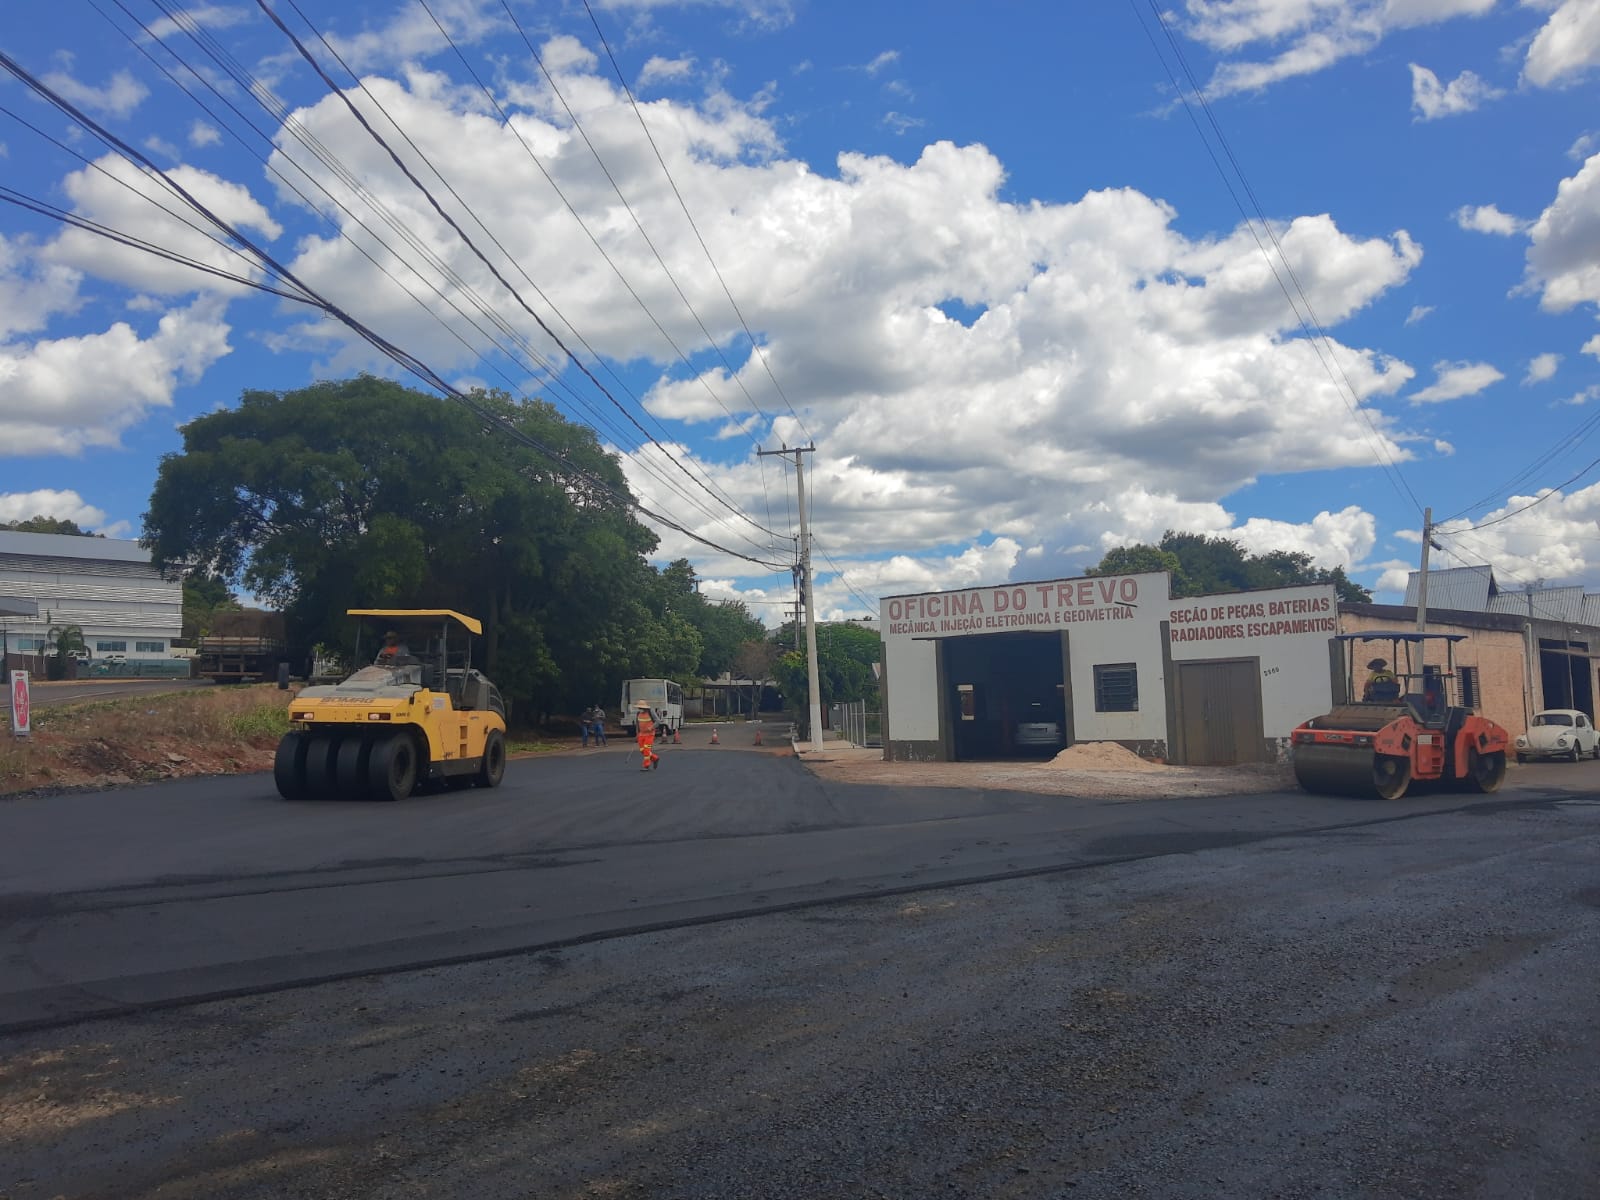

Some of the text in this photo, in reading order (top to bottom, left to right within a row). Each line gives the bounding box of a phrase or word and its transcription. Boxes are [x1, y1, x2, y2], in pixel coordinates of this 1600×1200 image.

[888, 578, 1138, 620] OFICINA DO TREVO
[1170, 606, 1208, 625] SEÇÃO
[1211, 606, 1225, 621] DE
[1269, 597, 1330, 616] BATERIAS
[940, 616, 982, 632] INJEÇÃO
[985, 611, 1051, 628] ELETRÔNICA
[1054, 611, 1061, 624] E
[1063, 606, 1134, 623] GEOMETRIA
[1247, 617, 1336, 637] ESCAPAMENTOS
